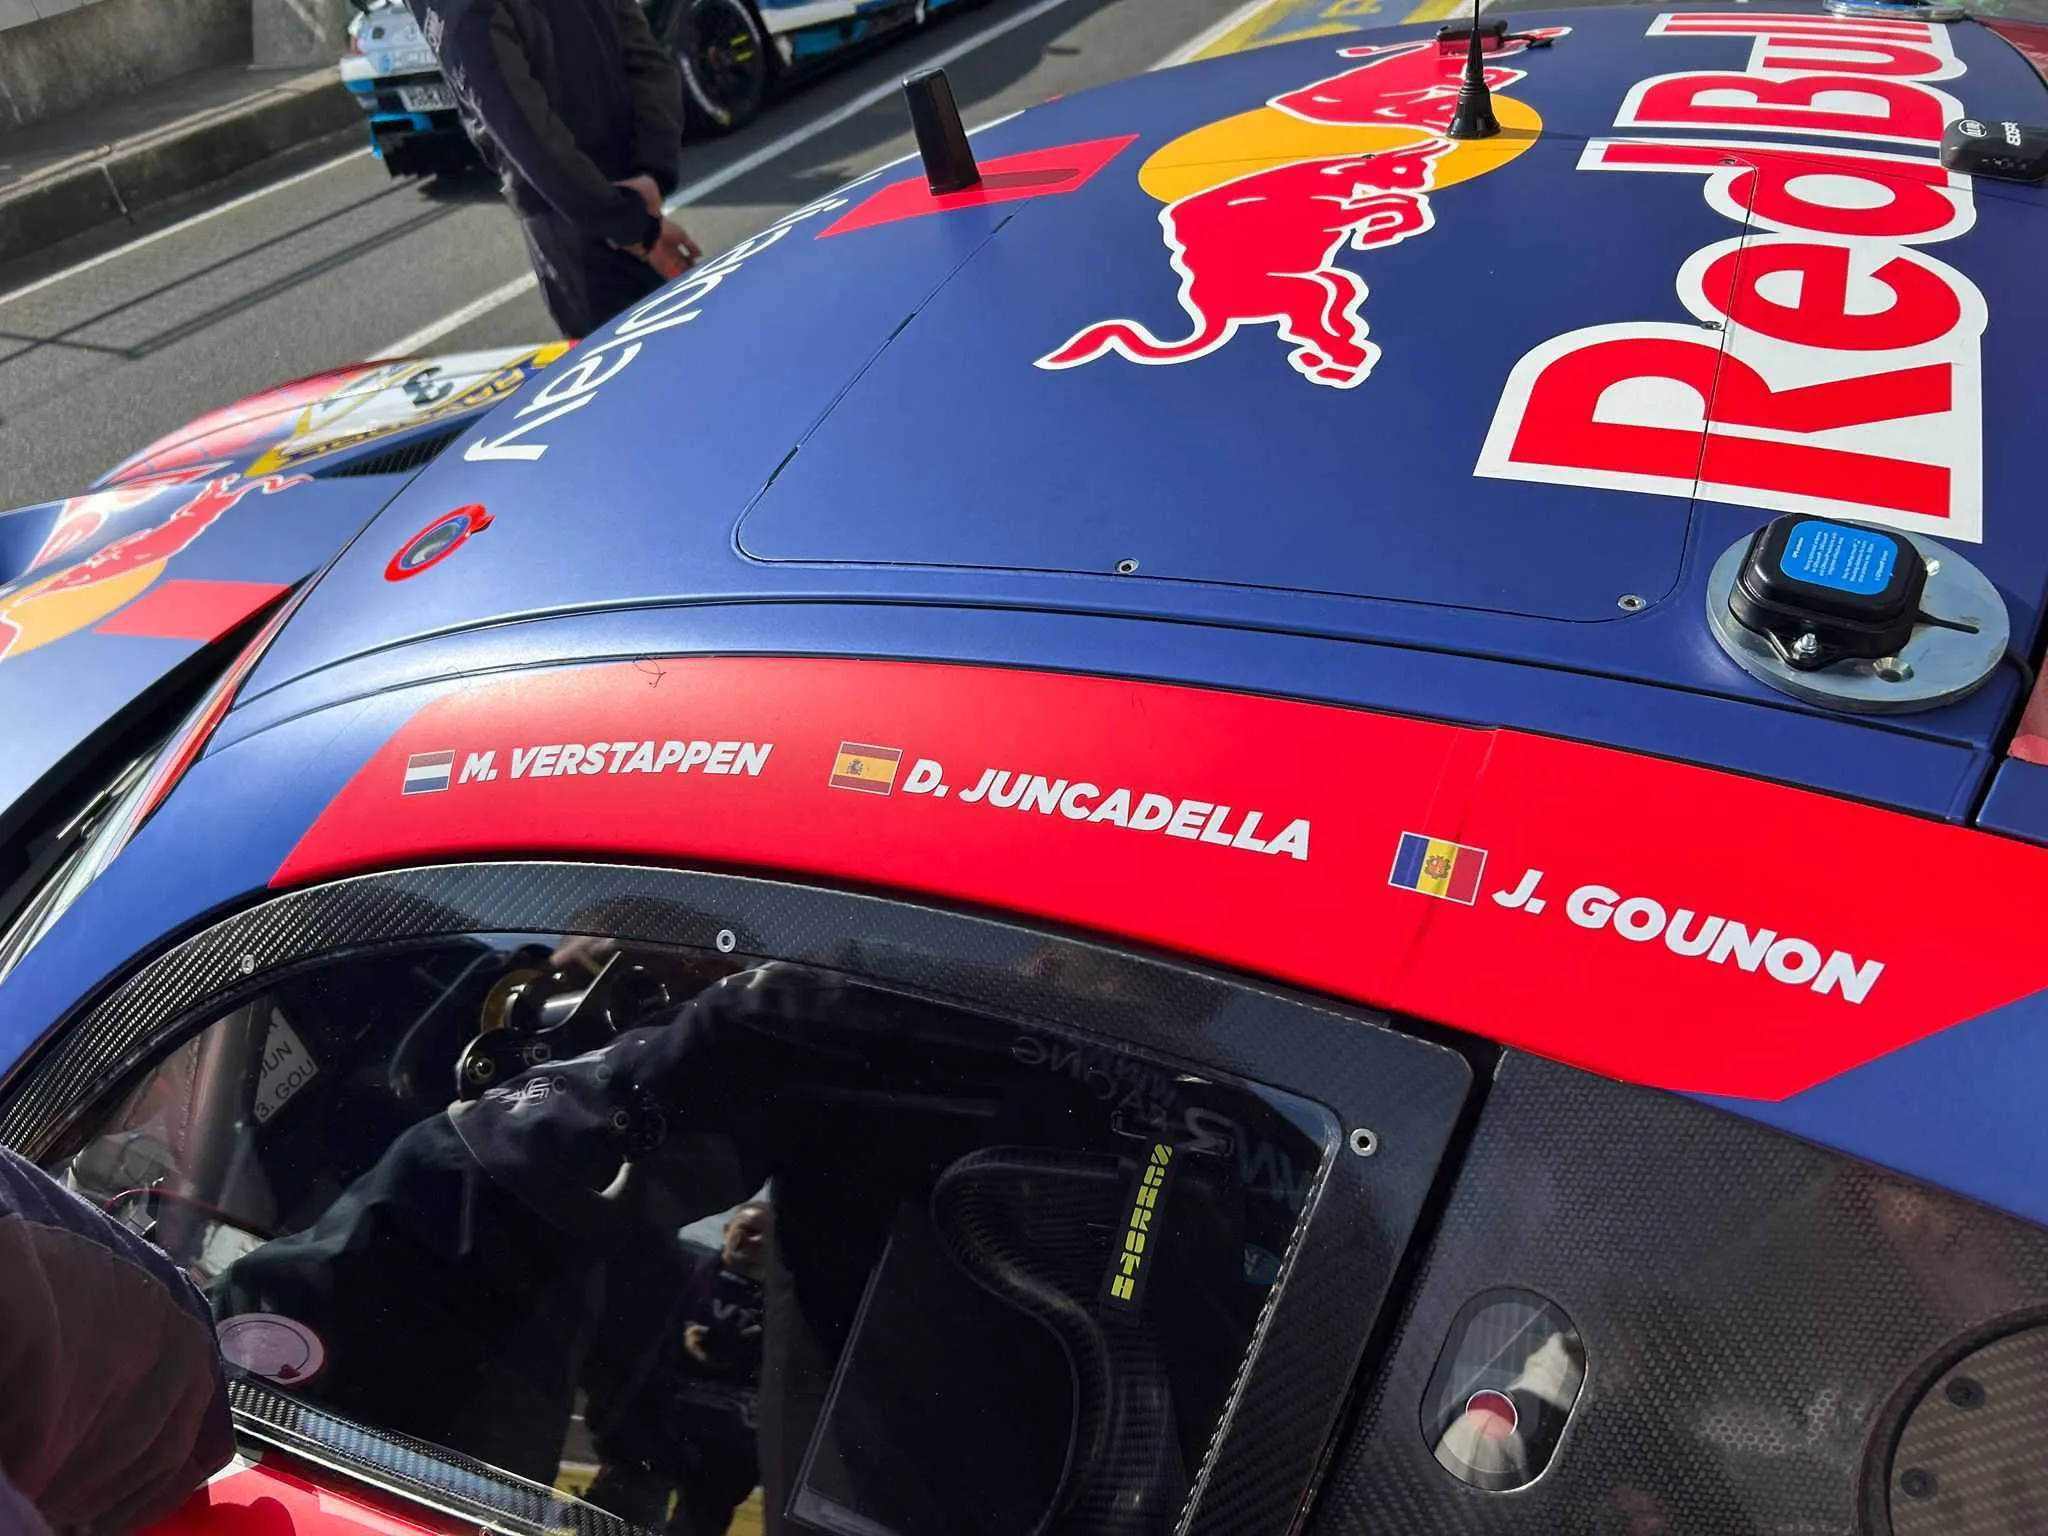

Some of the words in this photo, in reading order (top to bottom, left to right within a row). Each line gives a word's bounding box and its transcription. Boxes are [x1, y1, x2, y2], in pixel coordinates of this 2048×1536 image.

[1631, 15, 1947, 142] Bull
[1507, 142, 1962, 520] Red
[457, 750, 500, 785] M.
[509, 740, 774, 781] VERSTAPPEN
[902, 758, 949, 798] D.
[958, 768, 1311, 862] JUNCADELLA
[1492, 869, 1547, 915] J.
[1566, 884, 1885, 1006] GOUNON
[1110, 1143, 1174, 1300] SCHROTH
